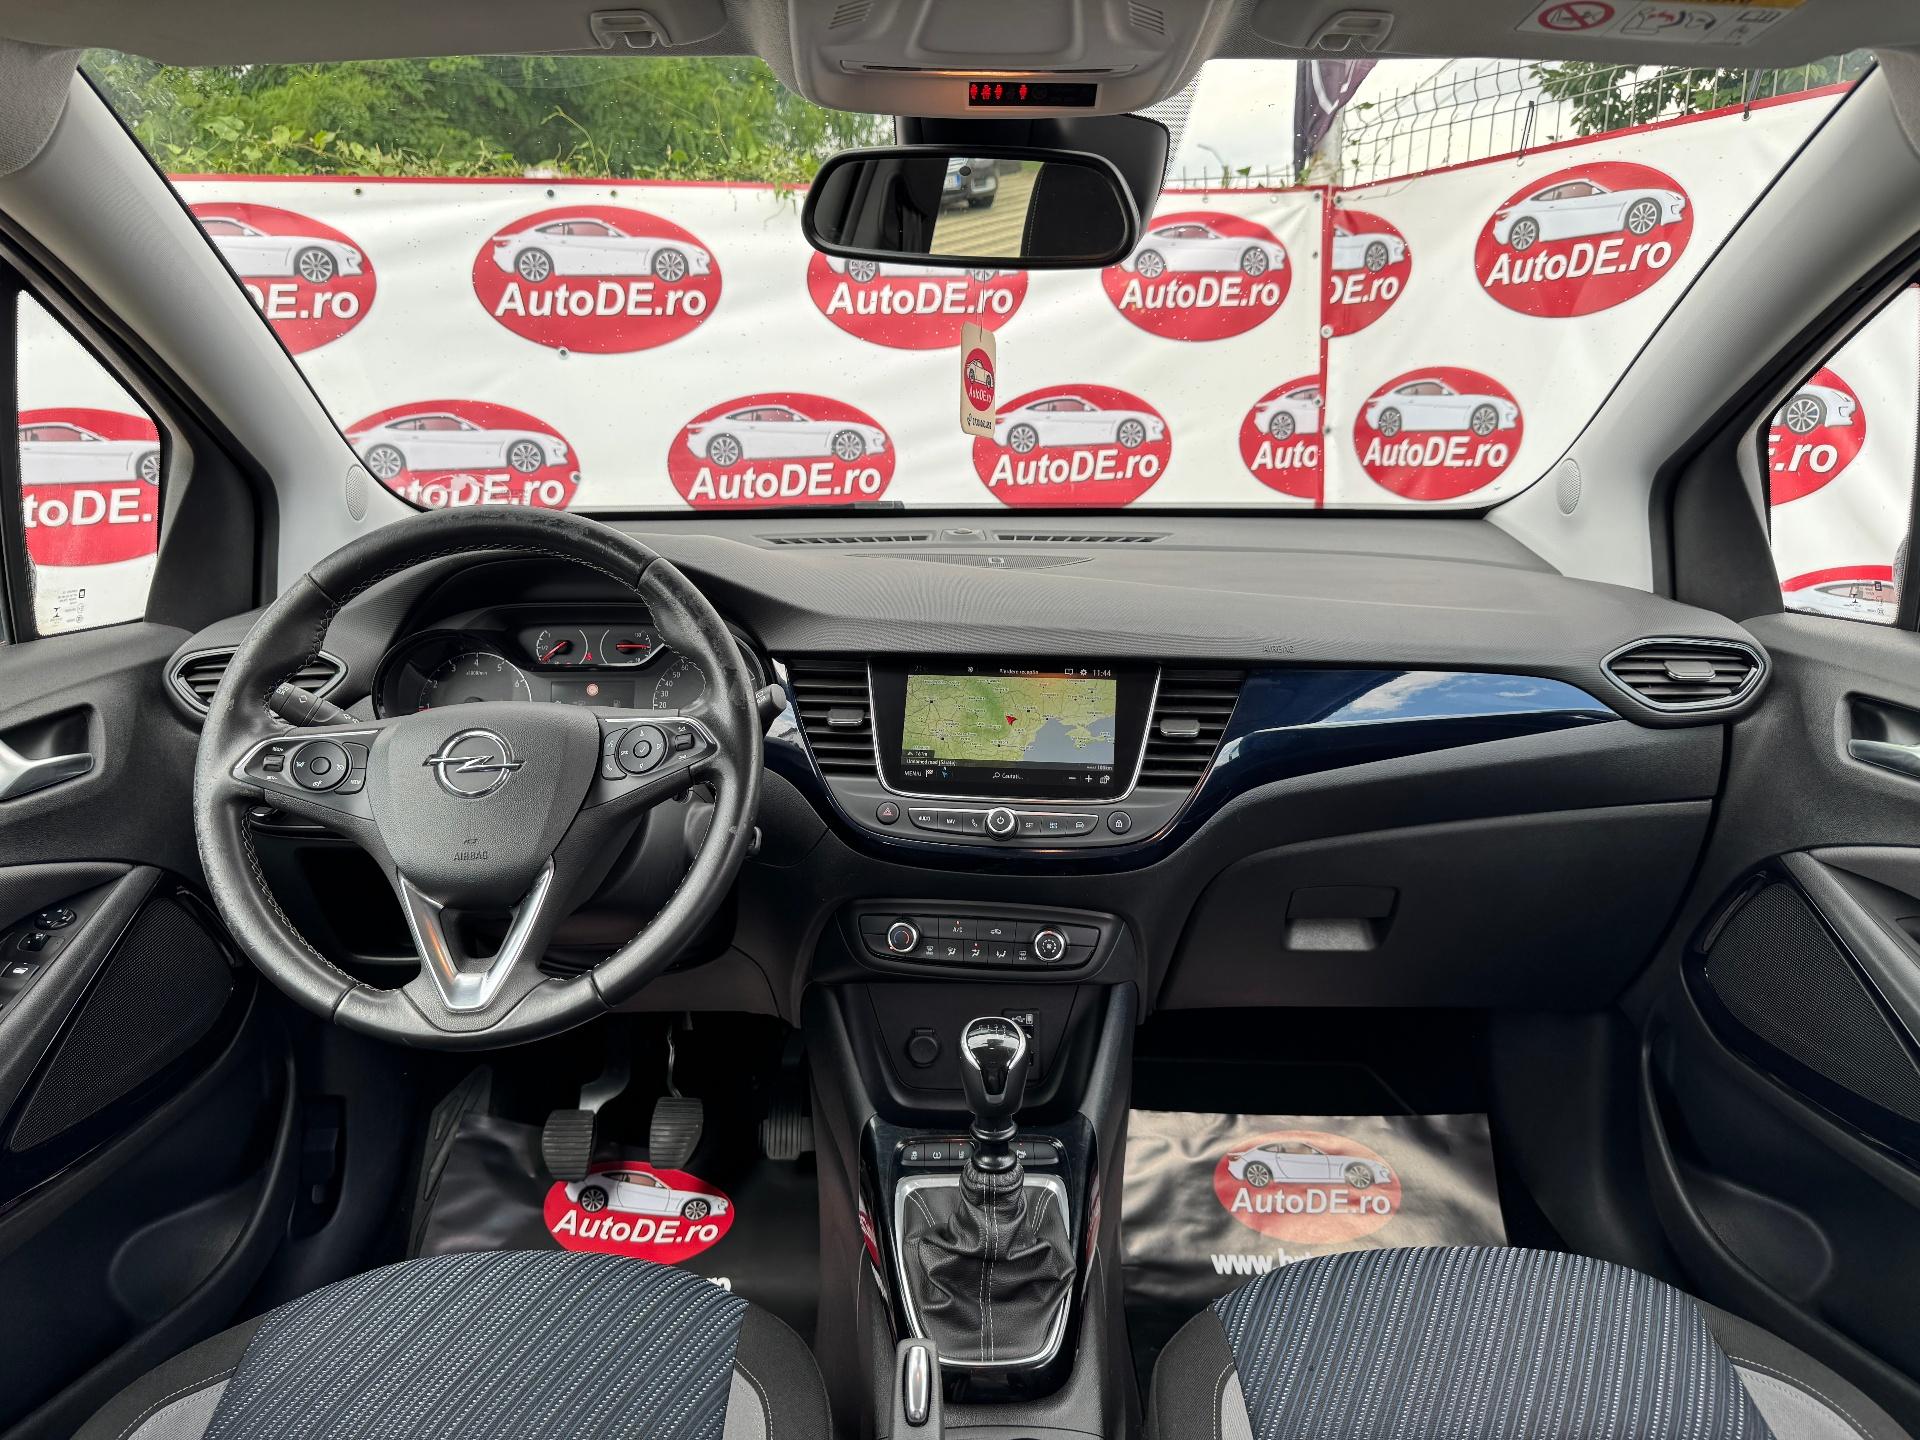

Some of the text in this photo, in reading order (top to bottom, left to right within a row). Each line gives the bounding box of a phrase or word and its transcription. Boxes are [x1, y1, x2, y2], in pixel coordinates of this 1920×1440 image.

[1484, 238, 1672, 287] AutoDE.ro
[495, 282, 707, 317] AutoDE.ro
[826, 281, 1013, 315] AutoDE.ro
[1119, 276, 1280, 309] AutoDE.ro
[1250, 440, 1318, 470] Auto
[1362, 436, 1509, 467] AutoDE.ro
[688, 462, 881, 501] AutoDE.ro
[988, 449, 1159, 487] AutoDE.ro
[451, 664, 457, 672] 3
[497, 663, 502, 671] 5
[1093, 669, 1111, 677] 11:44
[514, 680, 520, 688] 6
[1230, 1187, 1391, 1215] AutoDE.ro
[552, 1209, 719, 1244] AutoDE.ro
